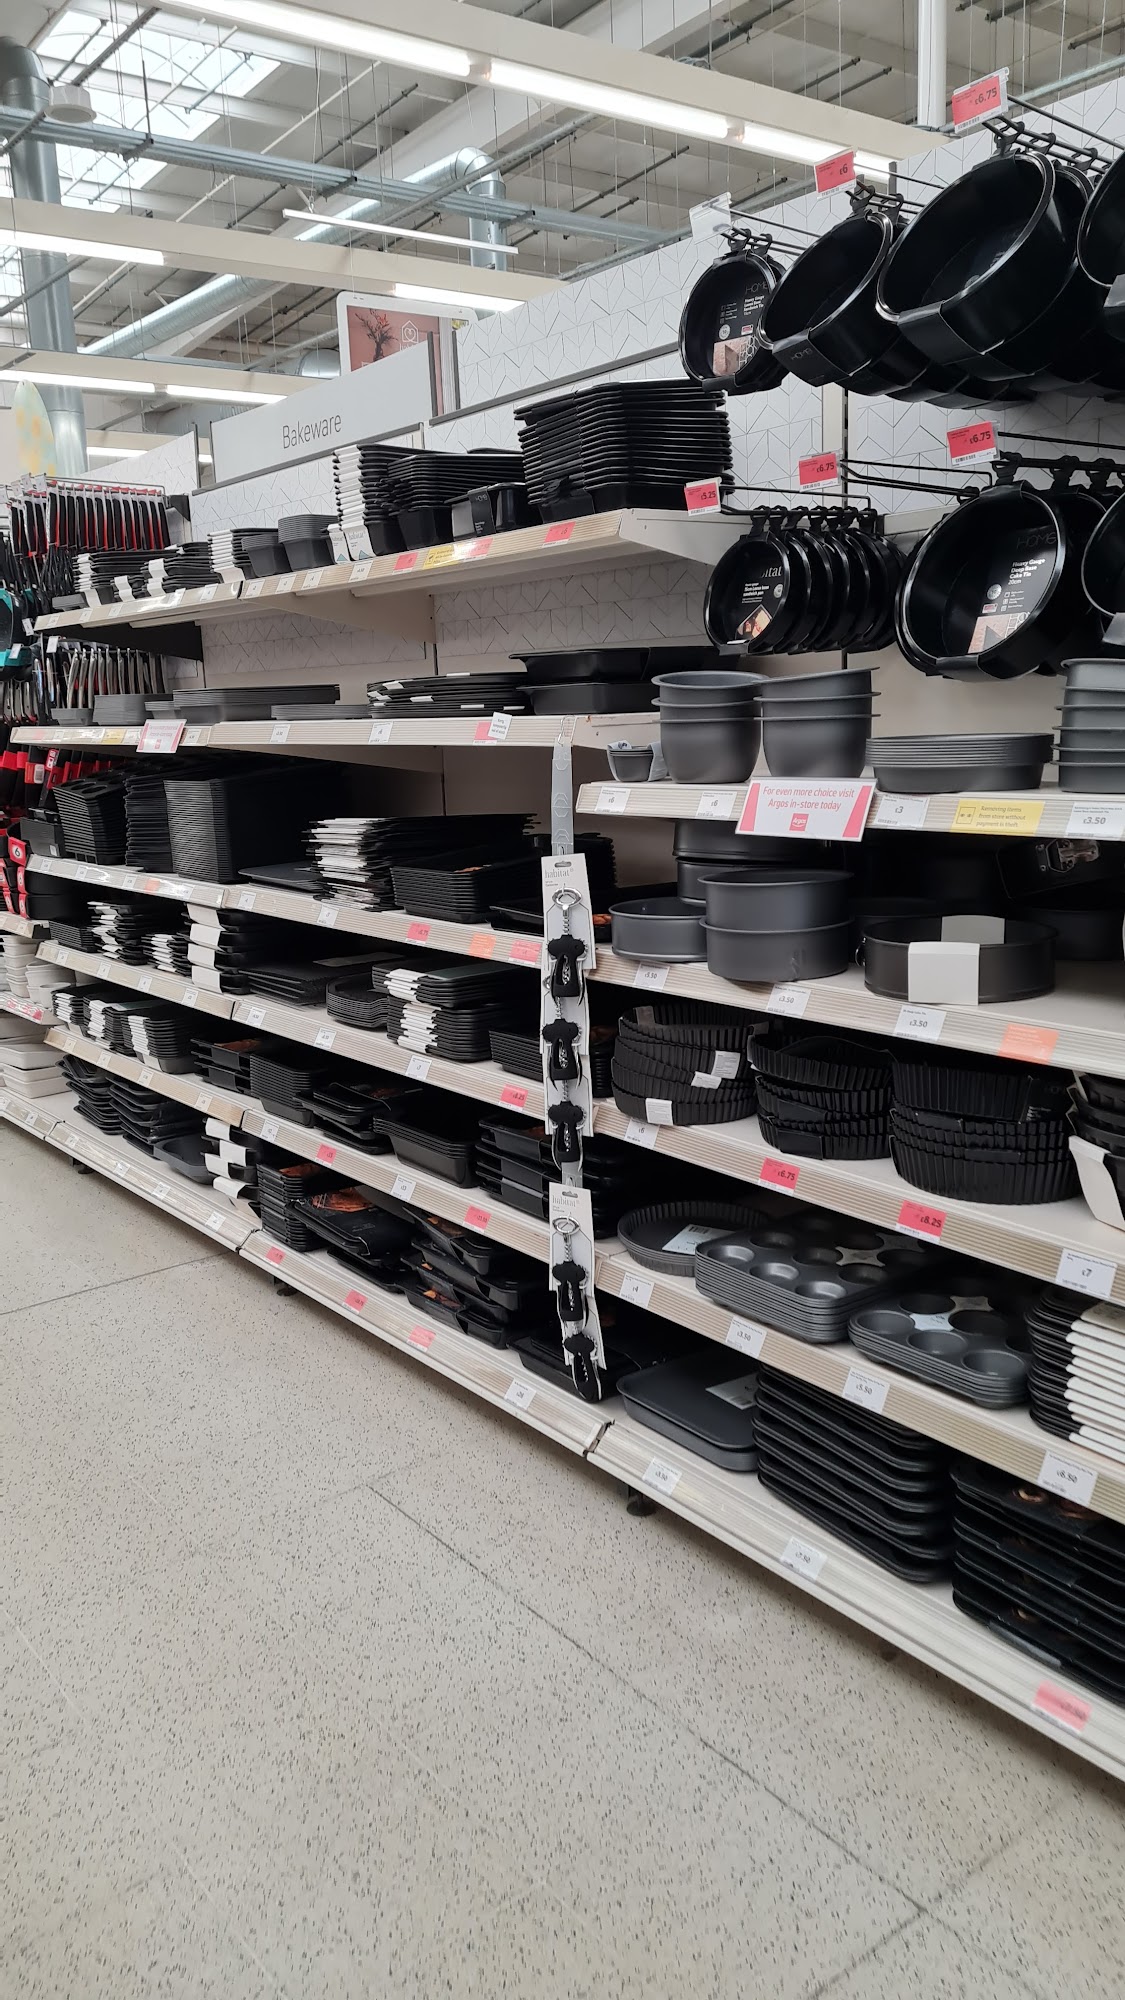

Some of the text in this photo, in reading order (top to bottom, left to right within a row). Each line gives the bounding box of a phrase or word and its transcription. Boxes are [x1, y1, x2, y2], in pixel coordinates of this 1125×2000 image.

[974, 87, 998, 105] £6.75
[839, 163, 848, 175] £6
[282, 414, 342, 449] Bakeware
[969, 430, 991, 444] £6.75
[816, 461, 835, 473] £6.75
[701, 490, 717, 500] £5.25
[1029, 558, 1046, 566] Gauge
[762, 786, 855, 798] For even more choice visit
[767, 798, 842, 812] Argos in-store today
[894, 805, 904, 814] £3
[980, 805, 1007, 813] Removing
[976, 820, 1000, 828] payment
[1083, 816, 1107, 825] £3.50
[14, 847, 21, 857] 6
[545, 868, 570, 878] habitat
[778, 995, 795, 1004] £3.50
[909, 1018, 928, 1028] £3.50
[777, 1169, 796, 1181] £6.75
[920, 1214, 942, 1228] £8.25
